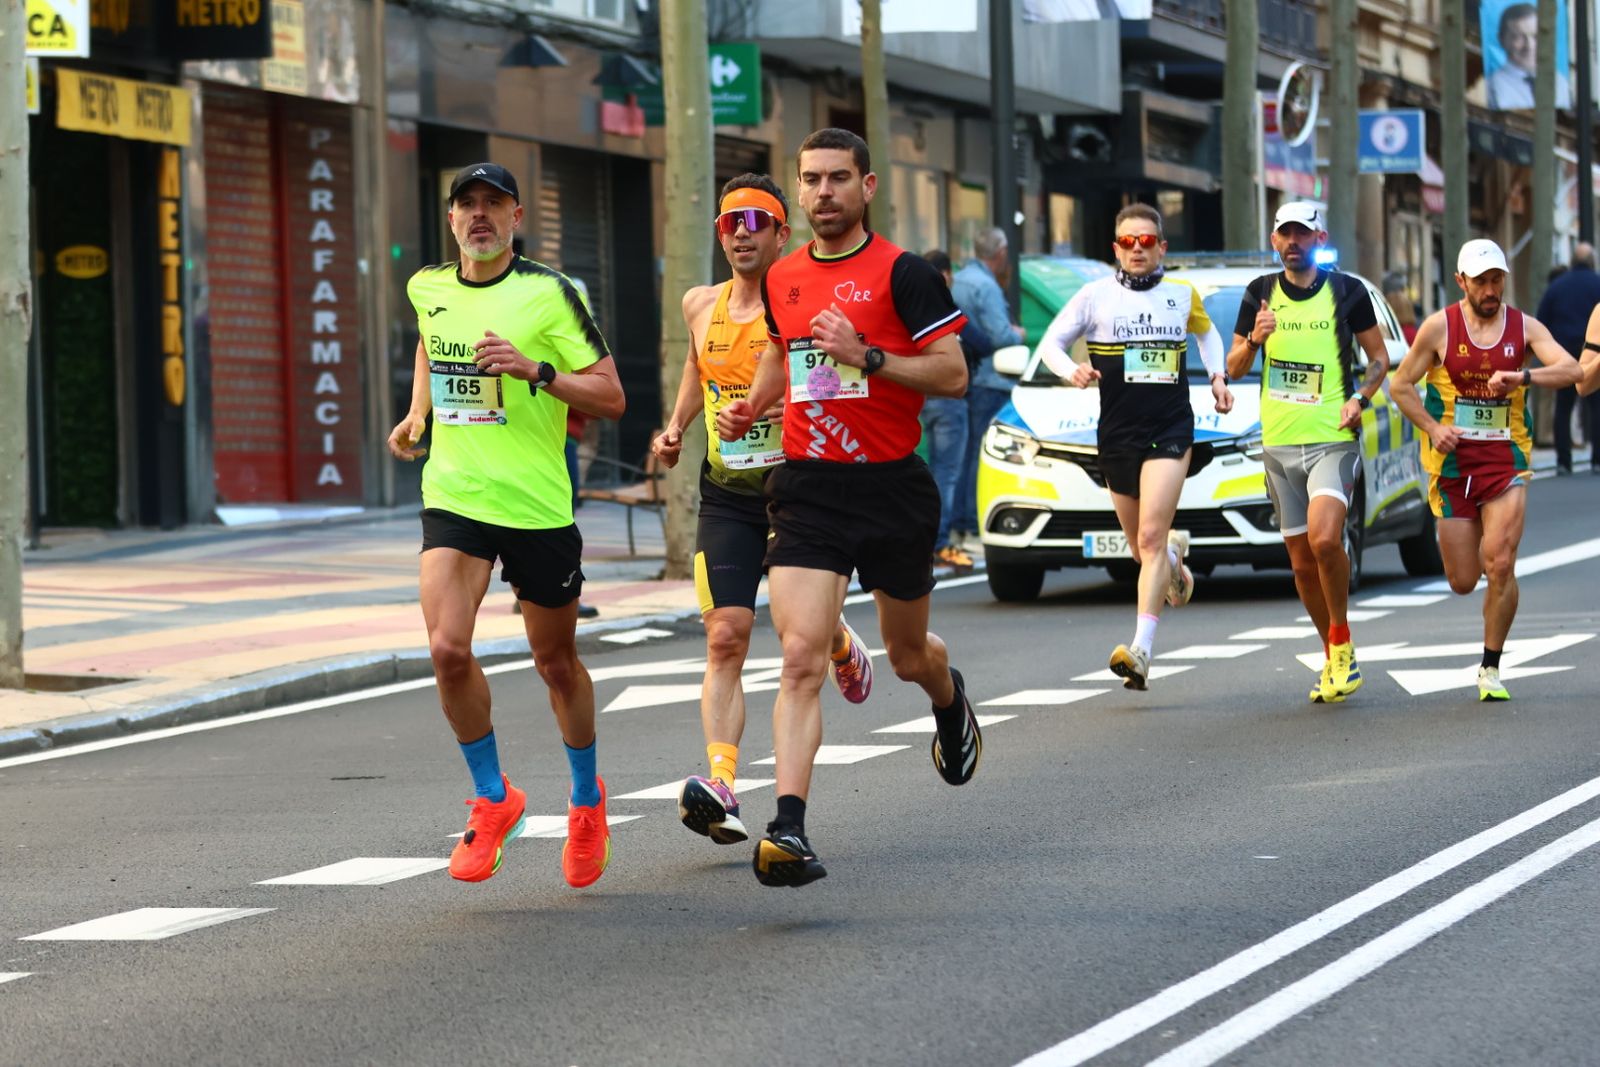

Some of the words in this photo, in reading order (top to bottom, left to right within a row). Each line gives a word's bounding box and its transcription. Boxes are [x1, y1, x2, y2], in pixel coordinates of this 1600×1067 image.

[177, 0, 261, 27] METRO
[79, 75, 119, 126] METRO
[135, 85, 174, 132] METRO
[308, 128, 344, 486] PARAFARMACIA
[1309, 320, 1330, 330] GO
[804, 352, 838, 369] 97
[1140, 351, 1166, 363] 671
[1281, 371, 1308, 384] 182
[445, 377, 481, 396] 165
[1475, 409, 1493, 420] 93
[1096, 535, 1130, 553] 557
